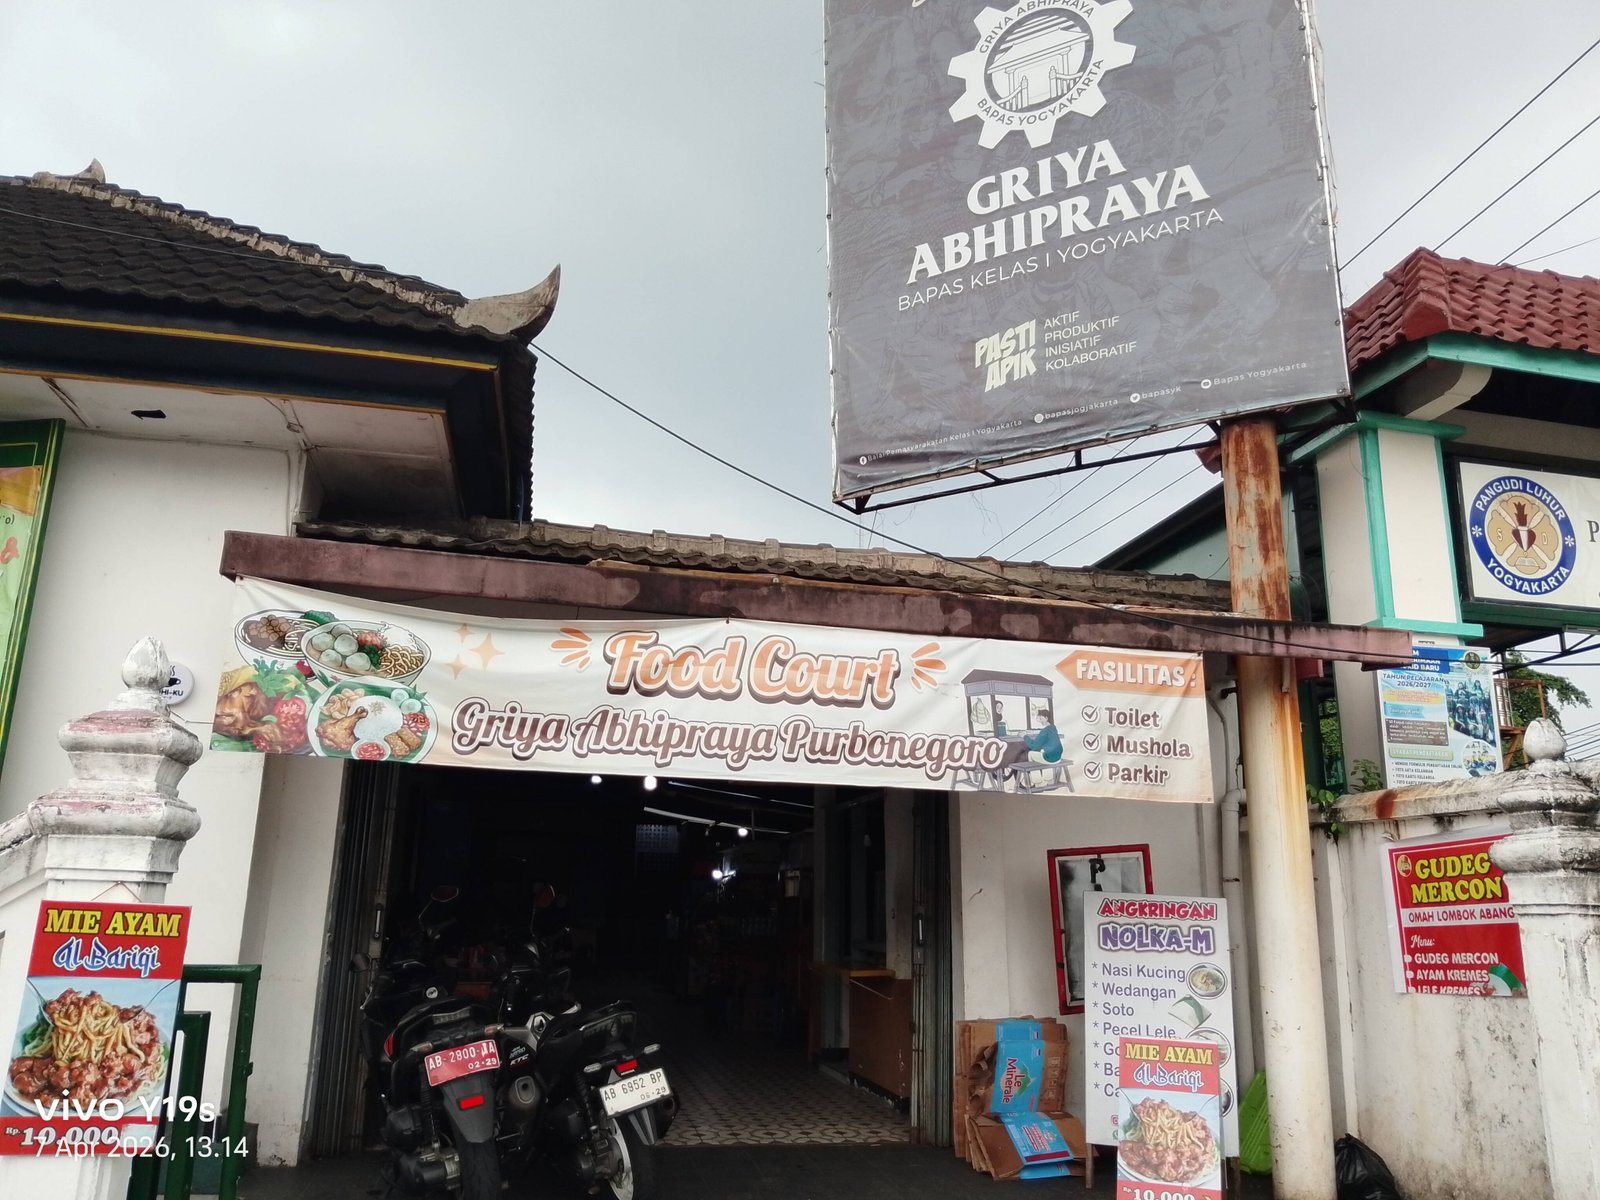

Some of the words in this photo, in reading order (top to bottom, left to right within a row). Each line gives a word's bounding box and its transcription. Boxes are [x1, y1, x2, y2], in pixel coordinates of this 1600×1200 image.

[979, 16, 1013, 54] GRIYA
[977, 97, 1014, 126] BAPAS
[1018, 59, 1104, 126] YOGYAKARTA
[966, 138, 1128, 215] GRIYA
[906, 164, 1211, 285] ABHIPRAYA
[897, 278, 964, 312] BAPAS
[970, 256, 1038, 290] KELAS
[1056, 207, 1224, 264] YOGYAKARTA
[1044, 310, 1080, 330] AKTIF
[1044, 315, 1120, 343] PRODUKTIF
[975, 319, 1037, 369] PASTI
[1045, 334, 1102, 358] INISIATIF
[1046, 341, 1137, 371] KOLABORATIF
[984, 348, 1037, 392] APIK
[1213, 372, 1245, 387] Bapas
[1247, 361, 1308, 380] Yogyakarta
[1142, 385, 1182, 401] bapasyk
[1044, 398, 1118, 421] bapasjogjakarta
[886, 437, 948, 457] Pemasyarakatan
[949, 431, 971, 442] Kelas
[977, 419, 1022, 437] Yogyakarta
[1475, 478, 1523, 512] PANGUDI
[1526, 482, 1566, 521] LUHUR
[1487, 557, 1571, 594] YOGYAKARTA
[603, 630, 747, 699] Food
[750, 634, 901, 710] Court
[1397, 680, 1431, 688] 2026/2027
[1105, 706, 1160, 728] Toilet
[452, 697, 570, 761] Griya
[570, 704, 778, 771] Abhipraya
[779, 714, 1007, 781] Purbonegoro
[1106, 734, 1191, 758] Mushola
[1108, 762, 1168, 784] Parkir
[1414, 852, 1491, 879] GUDEG
[1410, 876, 1502, 904] MERCON
[1097, 898, 1217, 920] ANGKRINGAN
[1408, 910, 1434, 923] OMAH
[1437, 910, 1477, 922] LOMBOK
[1479, 906, 1515, 920] ABANG
[43, 908, 102, 934] MIE
[105, 910, 182, 937] AYAM
[1414, 953, 1449, 965] GUDEG
[1451, 952, 1499, 965] MERCON
[1102, 962, 1132, 977] Nasi
[1136, 964, 1186, 982] Kucing
[1416, 969, 1444, 981] AYAM
[1448, 969, 1490, 982] KREMES
[1102, 982, 1176, 1001] Wedangan
[1102, 1001, 1135, 1016] Soto
[1103, 1022, 1141, 1036] Pecel
[1146, 1024, 1176, 1039] Lele
[428, 1055, 443, 1071] AB
[449, 1046, 476, 1063] 2800
[1125, 1042, 1160, 1061] MIE
[1164, 1046, 1214, 1065] AYAM
[604, 1087, 616, 1101] AB
[621, 1077, 646, 1094] 6952
[649, 1071, 662, 1084] BP
[1002, 1057, 1018, 1104] Minerale
[1013, 1073, 1026, 1088] Le
[5, 1126, 21, 1136] Rp.
